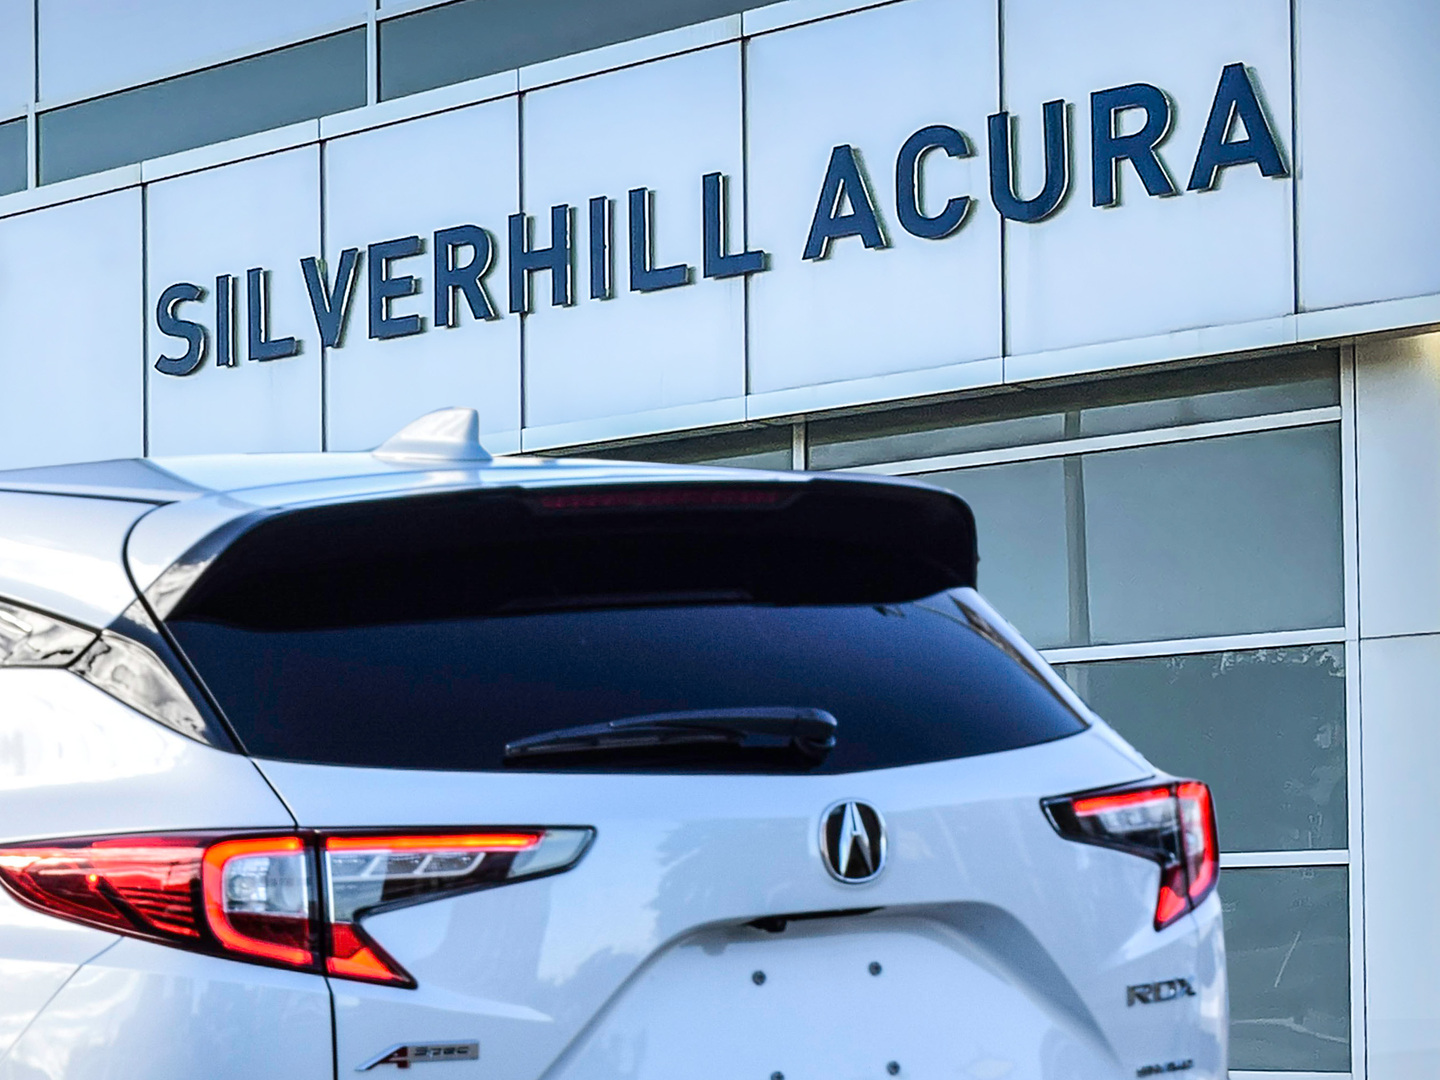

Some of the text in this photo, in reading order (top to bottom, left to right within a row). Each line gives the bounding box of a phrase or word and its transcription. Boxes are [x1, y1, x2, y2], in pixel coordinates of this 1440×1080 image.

[154, 62, 1291, 377] SILVERHILL ACURA
[1126, 978, 1196, 1007] RDX
